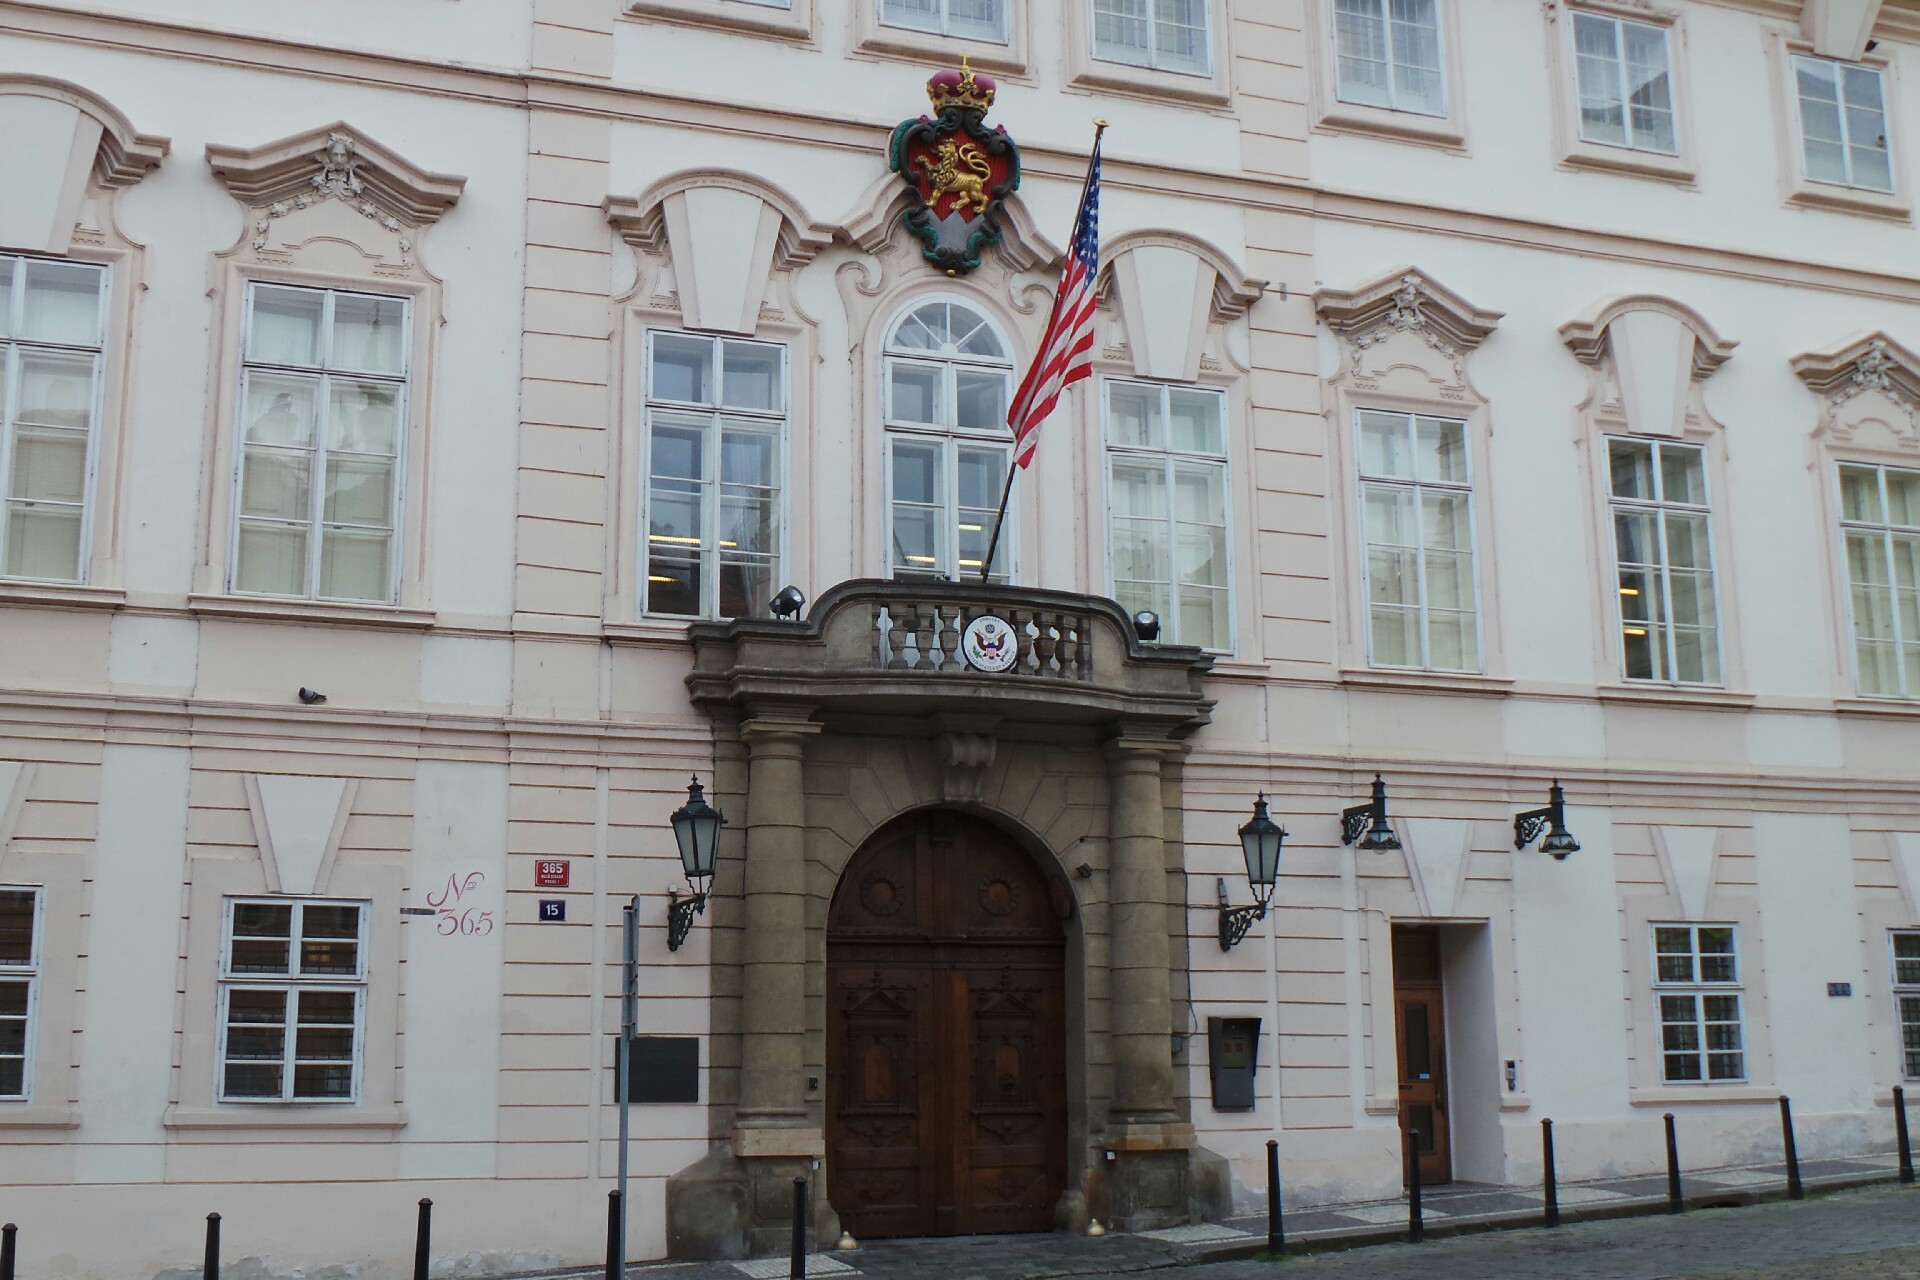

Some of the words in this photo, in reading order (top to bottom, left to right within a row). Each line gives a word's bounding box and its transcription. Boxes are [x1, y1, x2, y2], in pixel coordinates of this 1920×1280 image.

[542, 862, 563, 874] 365
[545, 904, 559, 916] 15
[437, 907, 494, 937] 365
